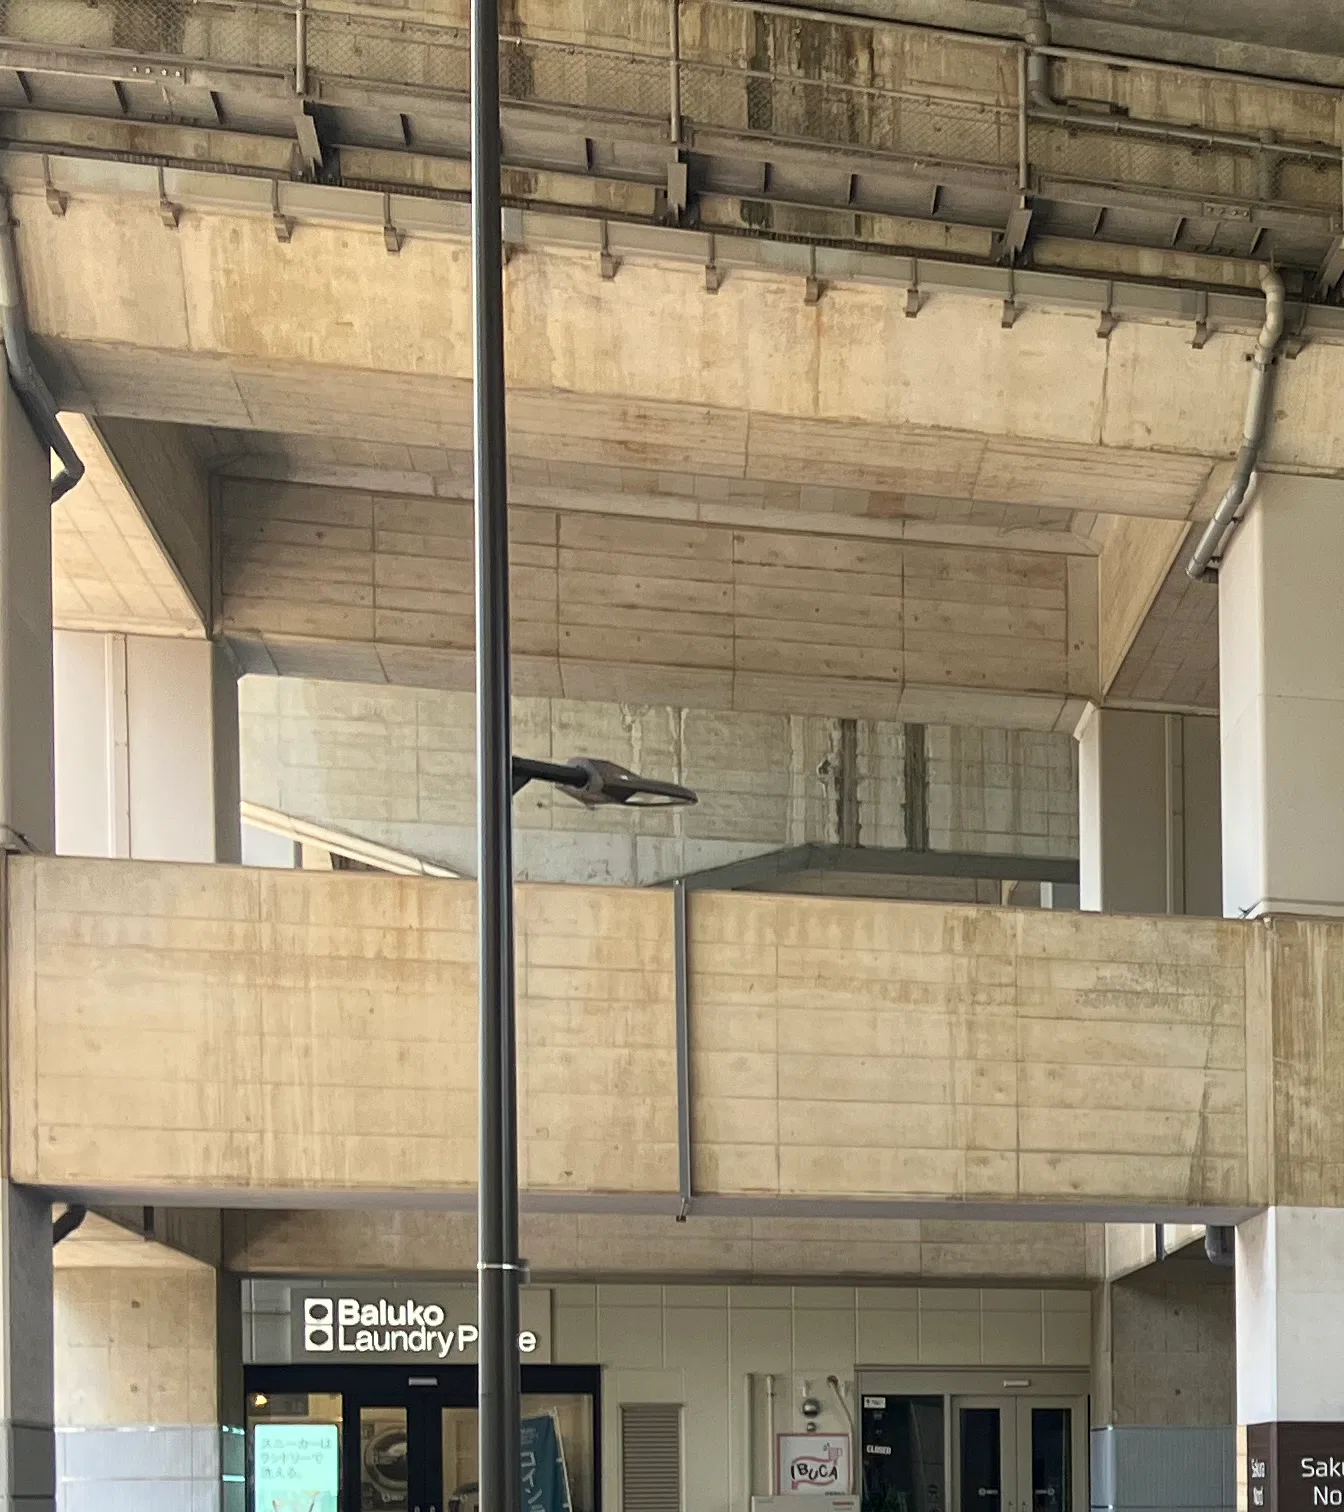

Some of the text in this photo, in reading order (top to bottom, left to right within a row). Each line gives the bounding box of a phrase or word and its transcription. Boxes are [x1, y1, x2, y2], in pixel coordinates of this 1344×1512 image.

[338, 1298, 445, 1327] Baluko
[338, 1324, 455, 1359] Laundry
[791, 1463, 838, 1481] IBUCA
